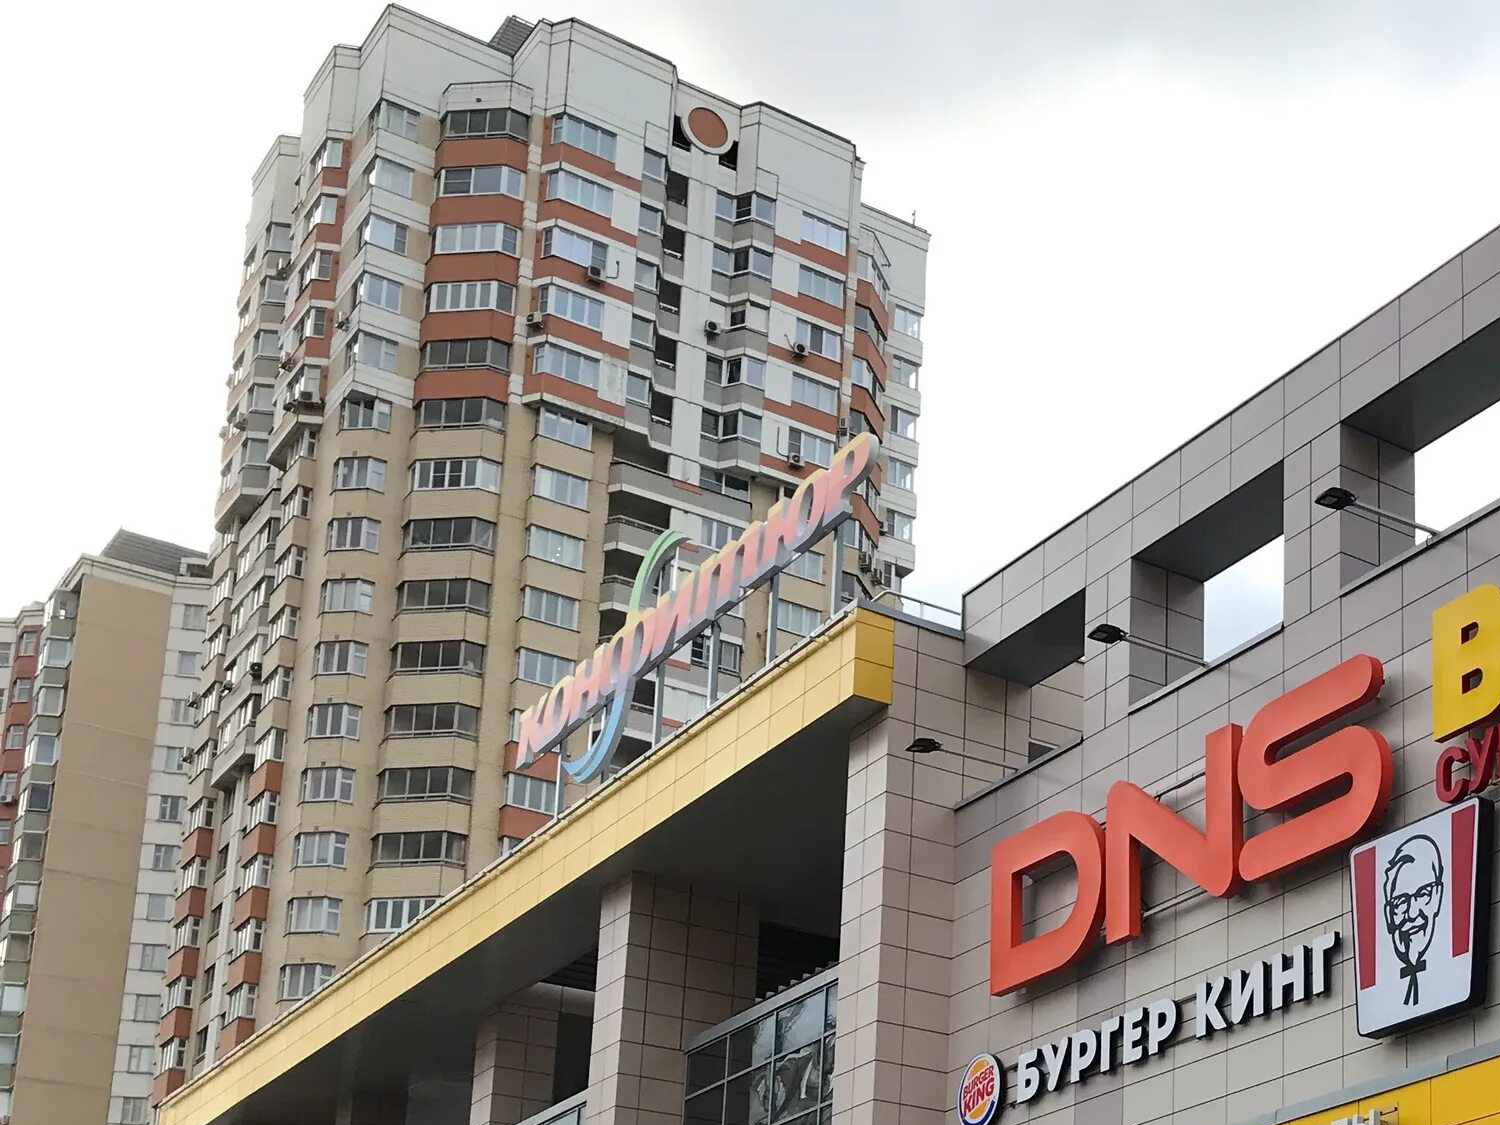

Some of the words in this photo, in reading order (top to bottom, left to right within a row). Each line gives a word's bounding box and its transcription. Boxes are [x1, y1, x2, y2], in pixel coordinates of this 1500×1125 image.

[990, 653, 1392, 995] DNS
[1016, 1001, 1181, 1103] БУРГЕР
[1195, 931, 1341, 1037] КИНГ
[963, 1065, 994, 1099] BURGER
[963, 1078, 995, 1117] KING
